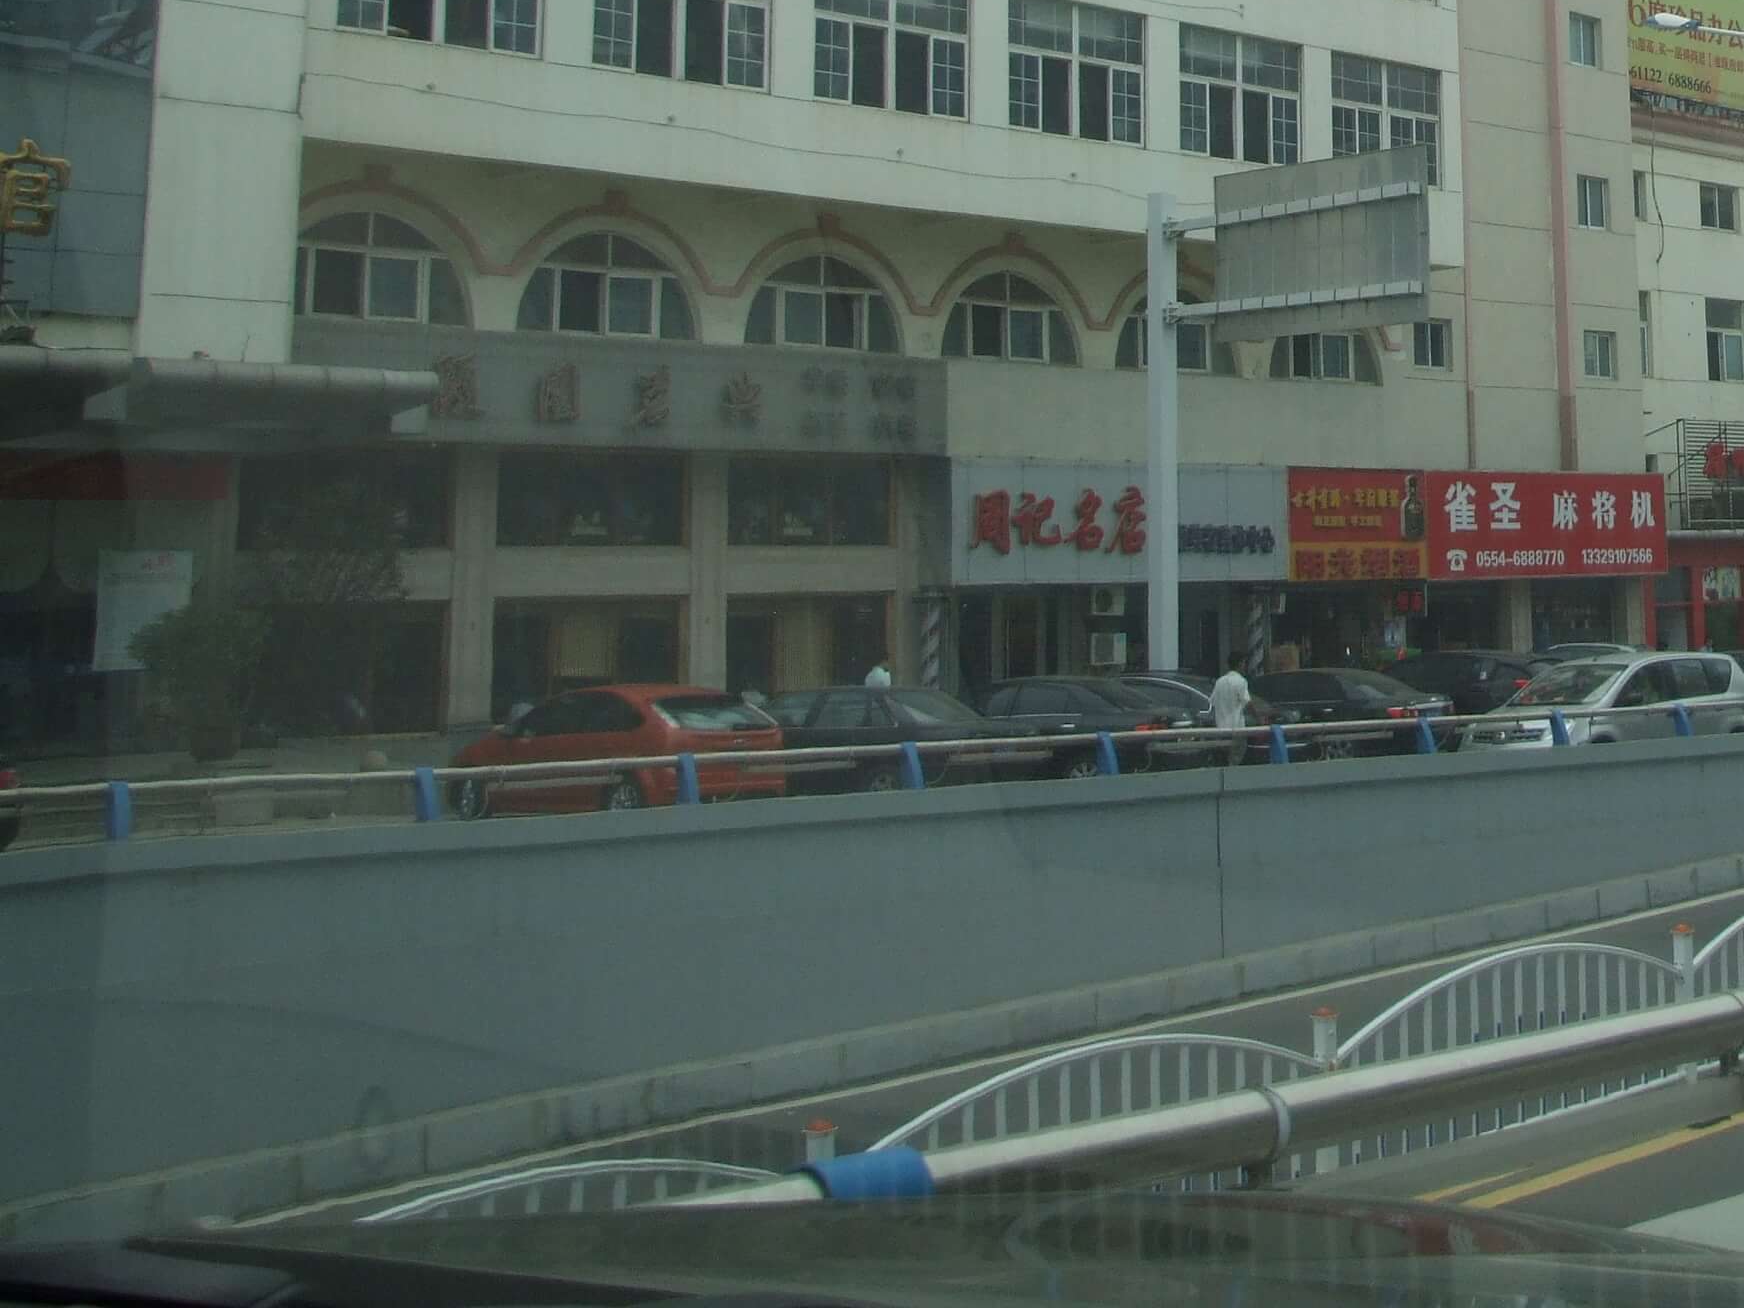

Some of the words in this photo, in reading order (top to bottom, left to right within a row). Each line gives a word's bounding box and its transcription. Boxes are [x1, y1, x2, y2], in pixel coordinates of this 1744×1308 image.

[1668, 72, 1712, 94] 6888666
[1443, 480, 1522, 533] 雀圣
[1552, 489, 1656, 531] 麻将机
[1475, 548, 1565, 568] 0554-6888770
